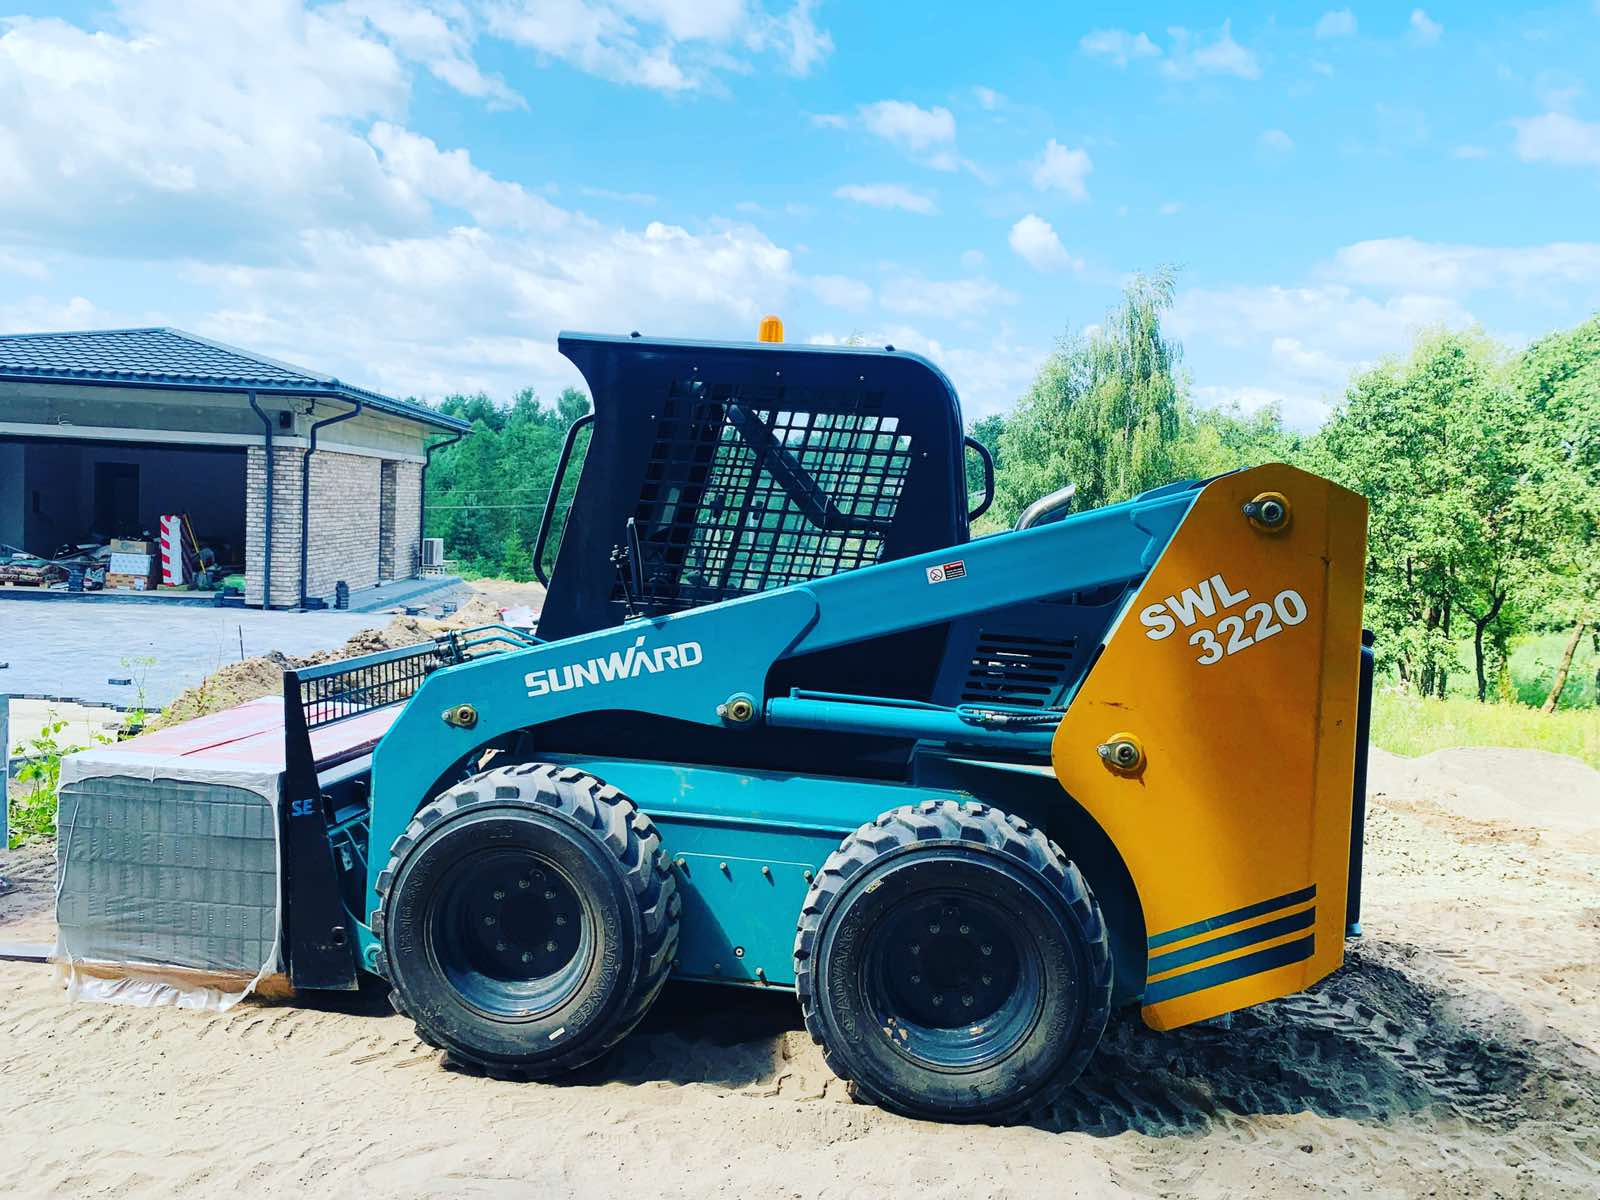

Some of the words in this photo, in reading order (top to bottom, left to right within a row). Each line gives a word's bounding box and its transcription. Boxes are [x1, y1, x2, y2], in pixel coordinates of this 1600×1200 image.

[1140, 573, 1250, 640] SWL
[1189, 589, 1308, 665] 3220
[524, 635, 703, 697] SUNWARD
